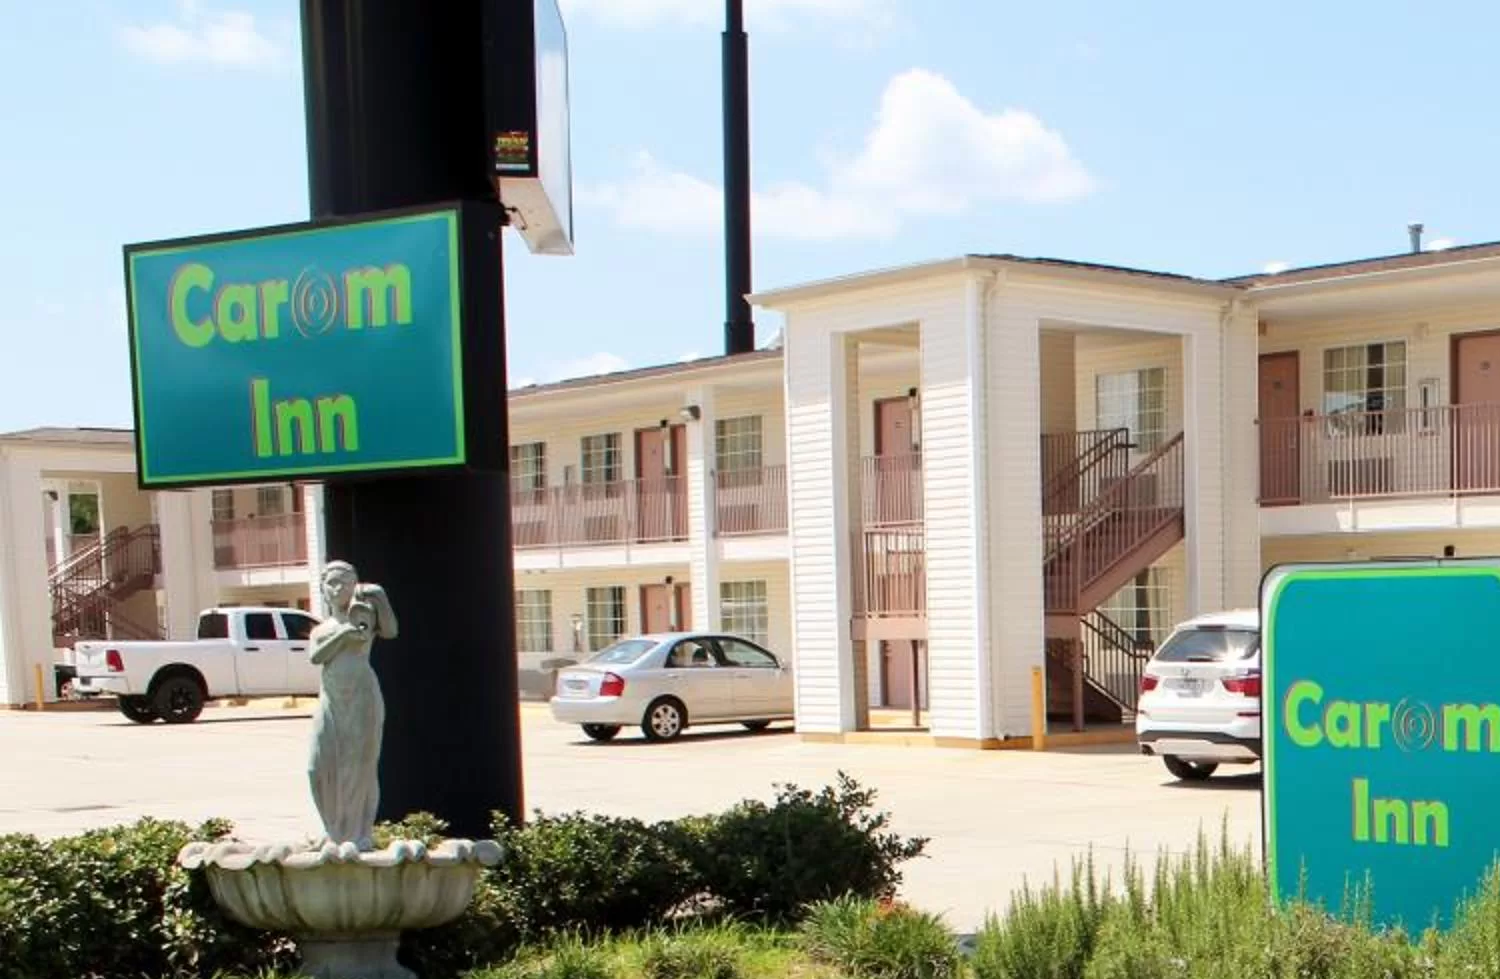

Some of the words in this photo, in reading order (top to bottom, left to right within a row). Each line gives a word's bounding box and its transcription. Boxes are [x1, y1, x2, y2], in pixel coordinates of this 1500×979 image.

[169, 262, 412, 348] Carom
[251, 378, 359, 458] Inn
[1351, 777, 1449, 847] Inn
